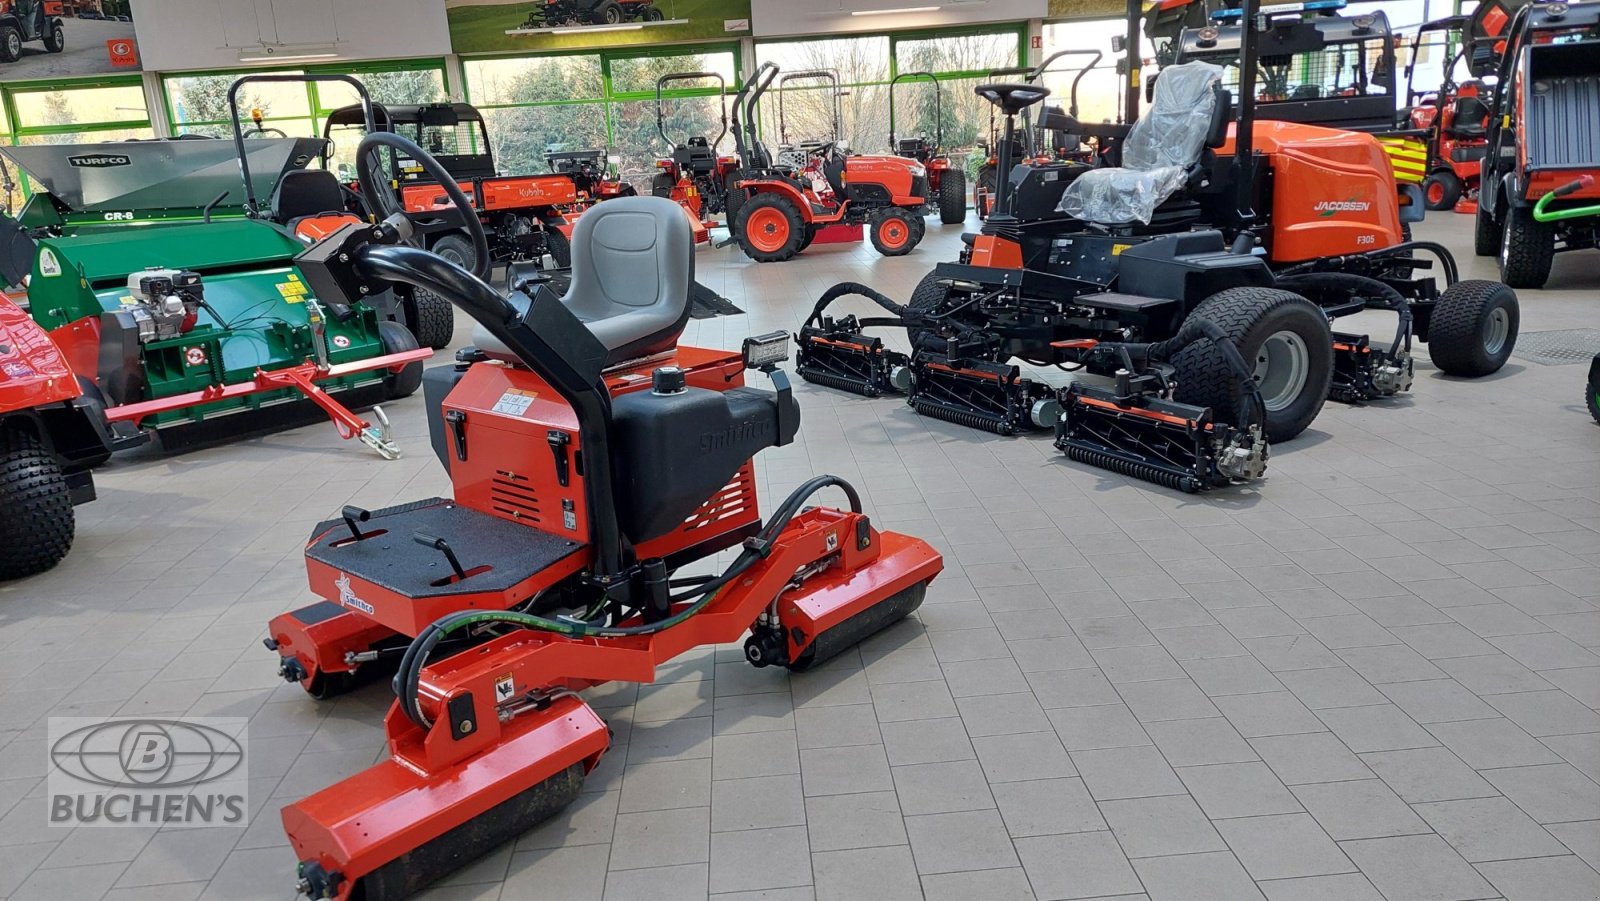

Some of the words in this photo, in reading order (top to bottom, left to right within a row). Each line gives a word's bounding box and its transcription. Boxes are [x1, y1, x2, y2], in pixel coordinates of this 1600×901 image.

[73, 157, 127, 165] TURFCO
[1314, 201, 1371, 211] JACOBSEN
[104, 212, 134, 221] CR-8
[1356, 234, 1375, 245] F305
[346, 595, 373, 614] Smithco
